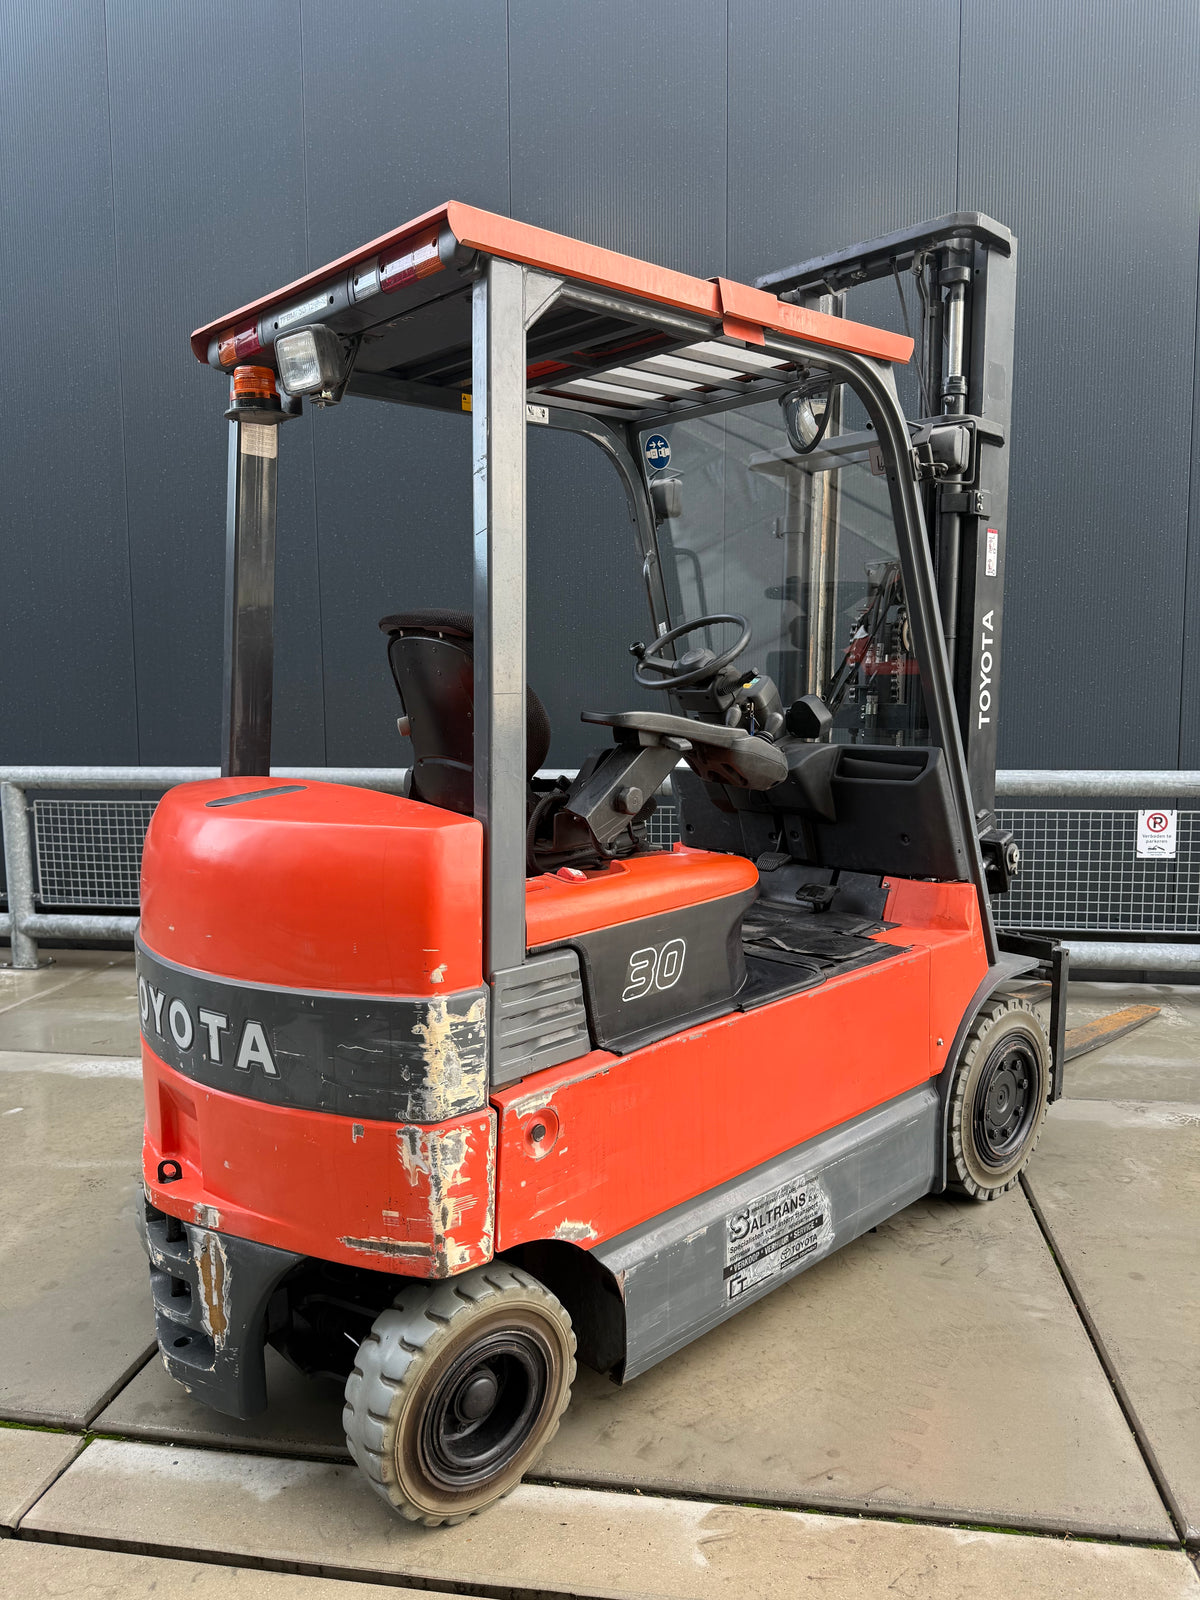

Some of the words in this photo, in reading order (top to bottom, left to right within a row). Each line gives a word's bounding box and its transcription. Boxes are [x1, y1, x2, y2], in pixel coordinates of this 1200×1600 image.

[978, 609, 994, 730] TOYOTA
[622, 938, 686, 1002] 30
[730, 1192, 806, 1243] SALTRANS
[791, 1232, 817, 1253] TOYOTA
[793, 1221, 814, 1239] SERVICE
